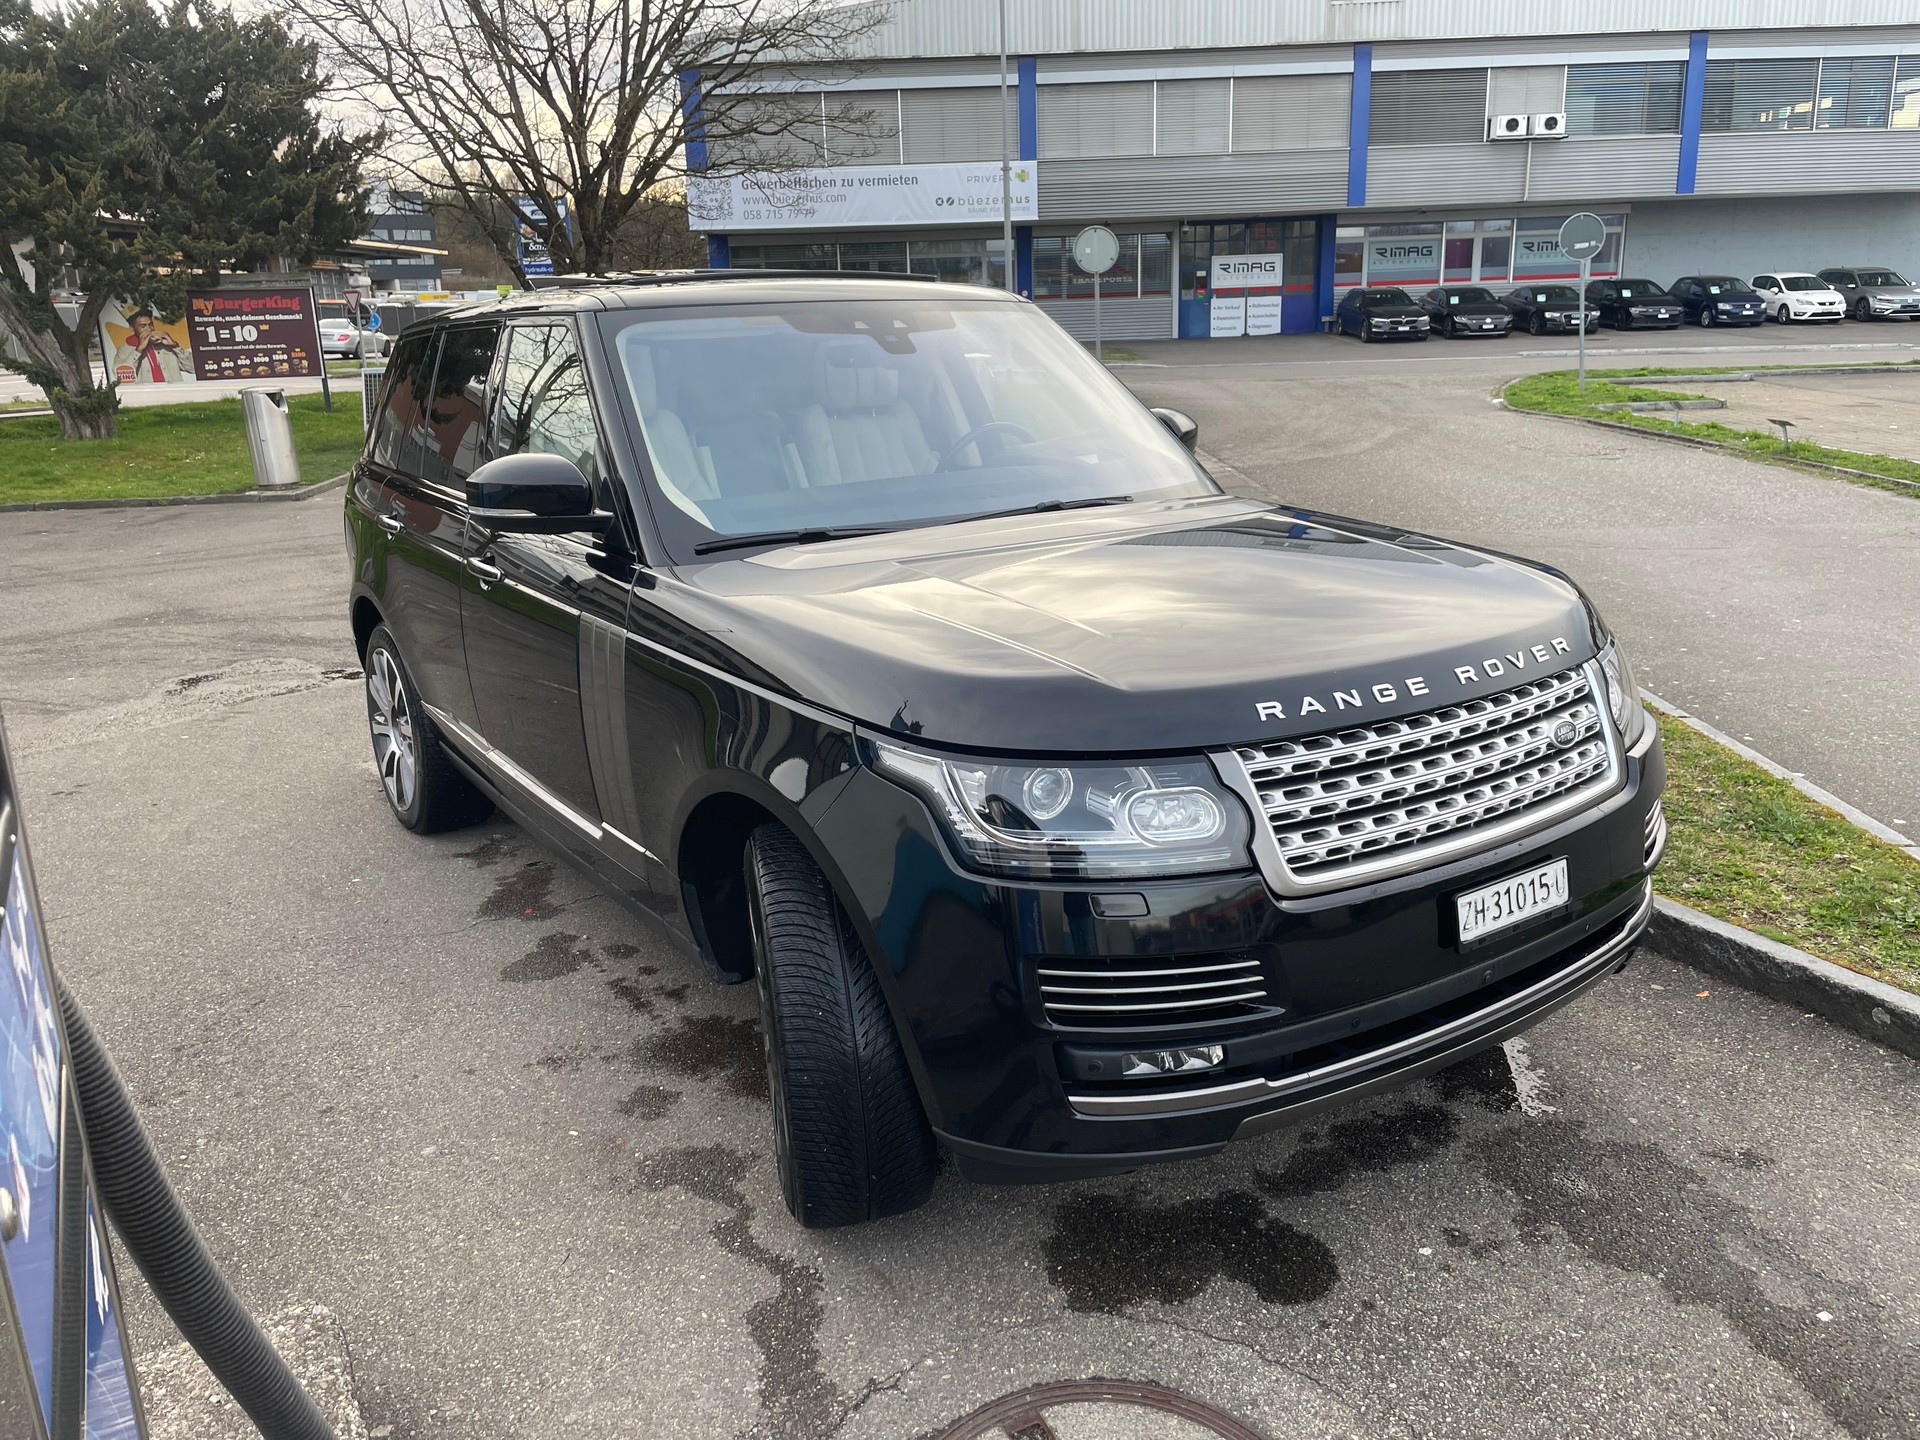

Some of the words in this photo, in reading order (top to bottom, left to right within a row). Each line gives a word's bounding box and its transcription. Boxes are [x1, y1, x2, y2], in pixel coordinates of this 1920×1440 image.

[741, 175, 837, 190] Gewerbeflächen
[841, 178, 854, 187] zu
[858, 174, 919, 187] vermieten
[743, 210, 762, 220] 058
[766, 209, 783, 219] 715
[787, 209, 799, 219] 79
[803, 208, 815, 218] 79
[1375, 245, 1433, 258] RIMAG
[1219, 261, 1276, 274] RIMAG
[191, 295, 301, 315] MyBurgerKing
[1254, 676, 1430, 722] RANGE
[1453, 636, 1571, 685] ROVER
